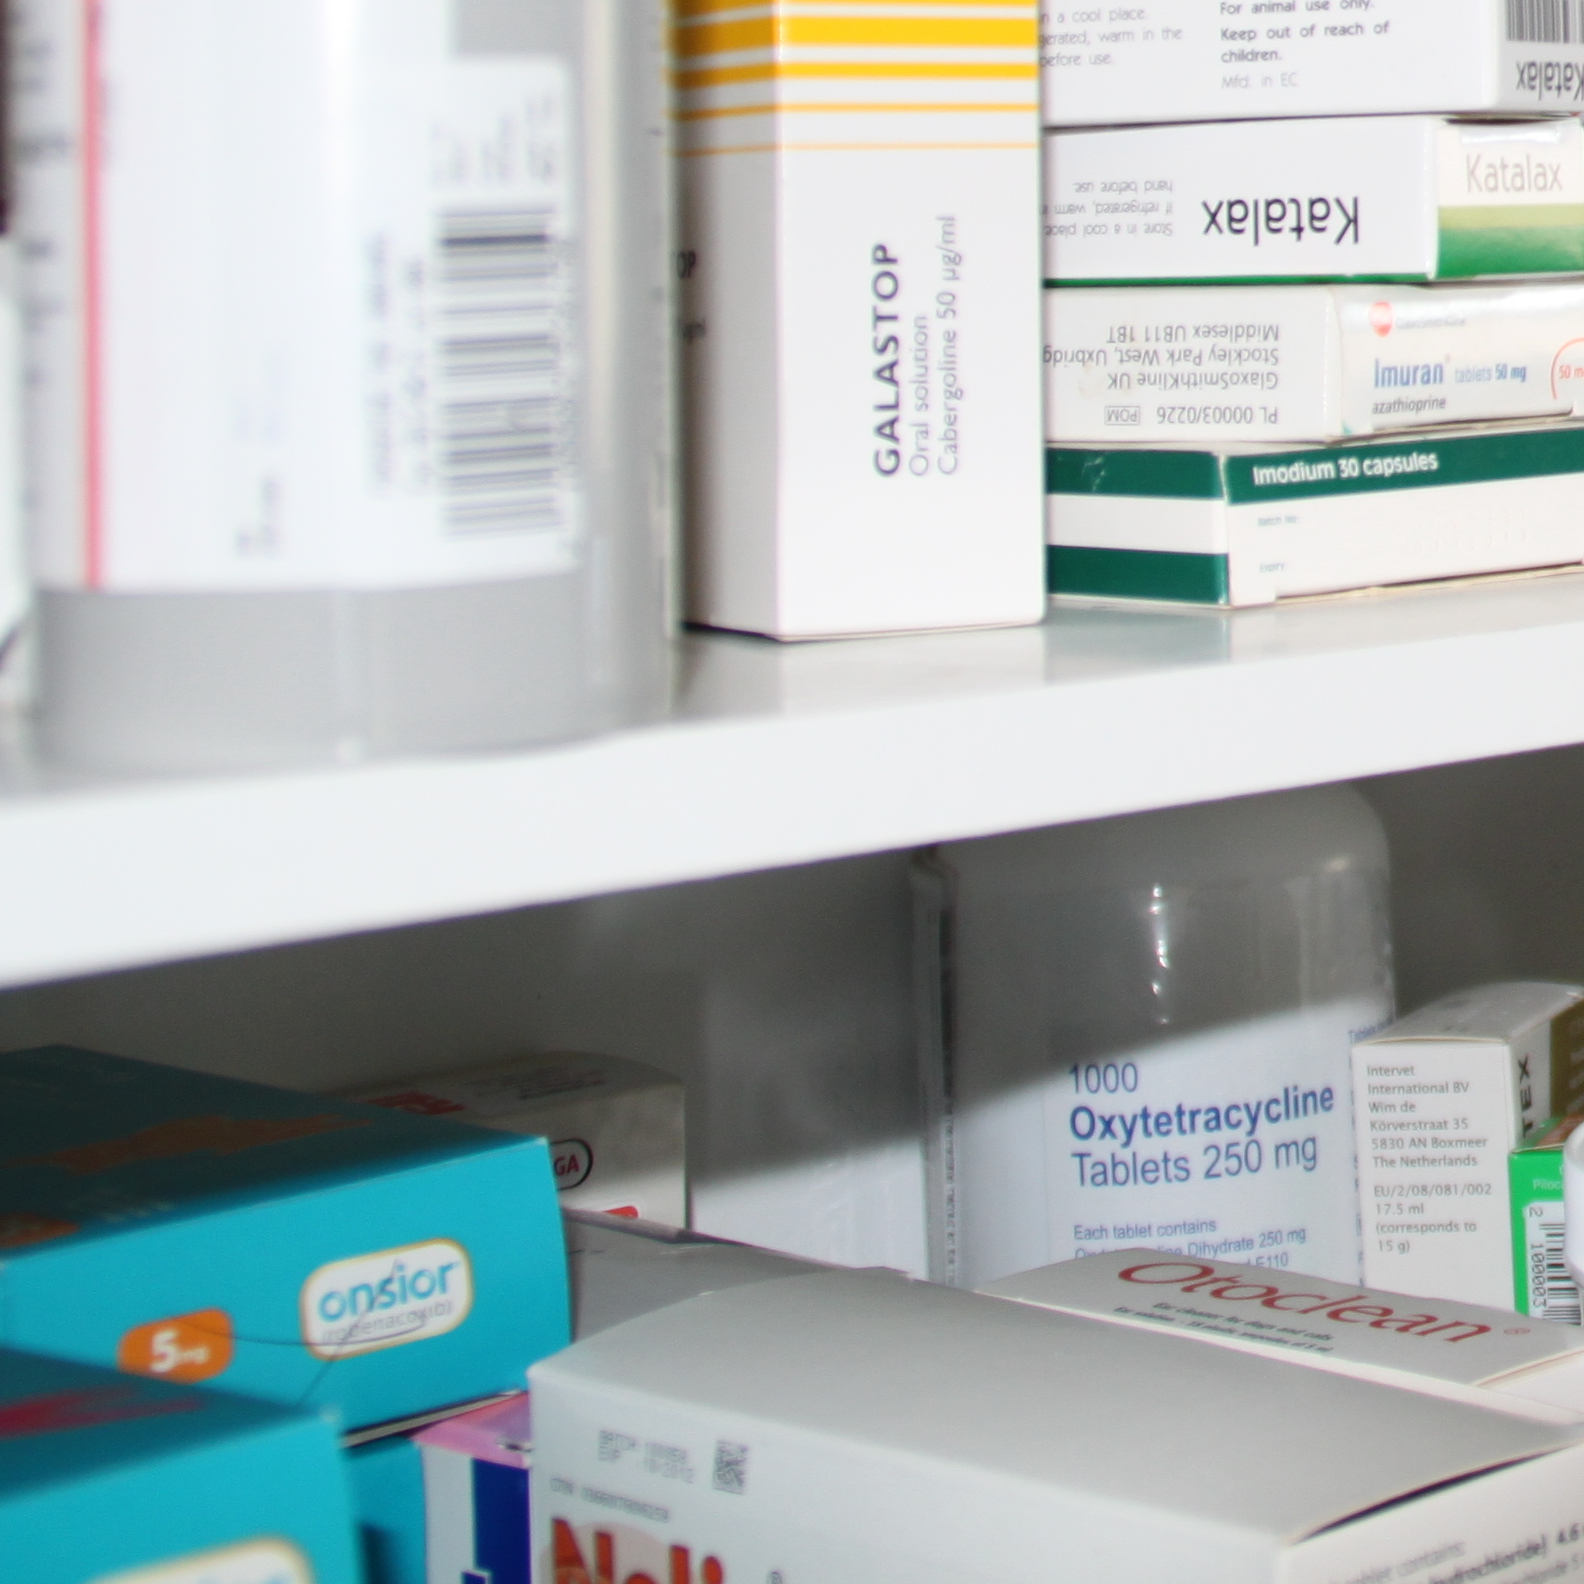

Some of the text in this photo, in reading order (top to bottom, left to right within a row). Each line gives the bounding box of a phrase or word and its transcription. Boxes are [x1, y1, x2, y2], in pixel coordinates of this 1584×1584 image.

[1220, 0, 1242, 16] For
[1220, 46, 1282, 63] children.
[1464, 152, 1563, 196] Katalax
[1201, 195, 1359, 247] Katalax
[938, 289, 957, 320] 50
[1106, 323, 1280, 344] Middlesex UB11 1BT
[871, 242, 901, 479] GALASTOP
[1113, 346, 1280, 368] Stockley Park West,
[1136, 369, 1279, 391] GlaxoSmithKline
[1373, 357, 1445, 389] Imuran
[909, 312, 930, 477] Oral solution
[937, 323, 965, 477] Cabergoline
[1372, 395, 1447, 415] azathioprine
[1156, 404, 1279, 425] PL 00003/0226
[1253, 450, 1438, 487] Imodium 30 capsules
[1067, 1062, 1139, 1095] 1000
[1366, 1065, 1415, 1077] Intervet
[1367, 1081, 1470, 1096] International BV
[1069, 1085, 1335, 1149] Oxytetracycline
[1431, 1136, 1488, 1149] Boxmeer
[1071, 1136, 1319, 1189] Tablets 250 mg
[1400, 1154, 1478, 1168] Netherlands
[1373, 1182, 1493, 1199] EU/2/08/081/002
[317, 1260, 455, 1324] onsior
[1117, 1261, 1493, 1344] Otoclean
